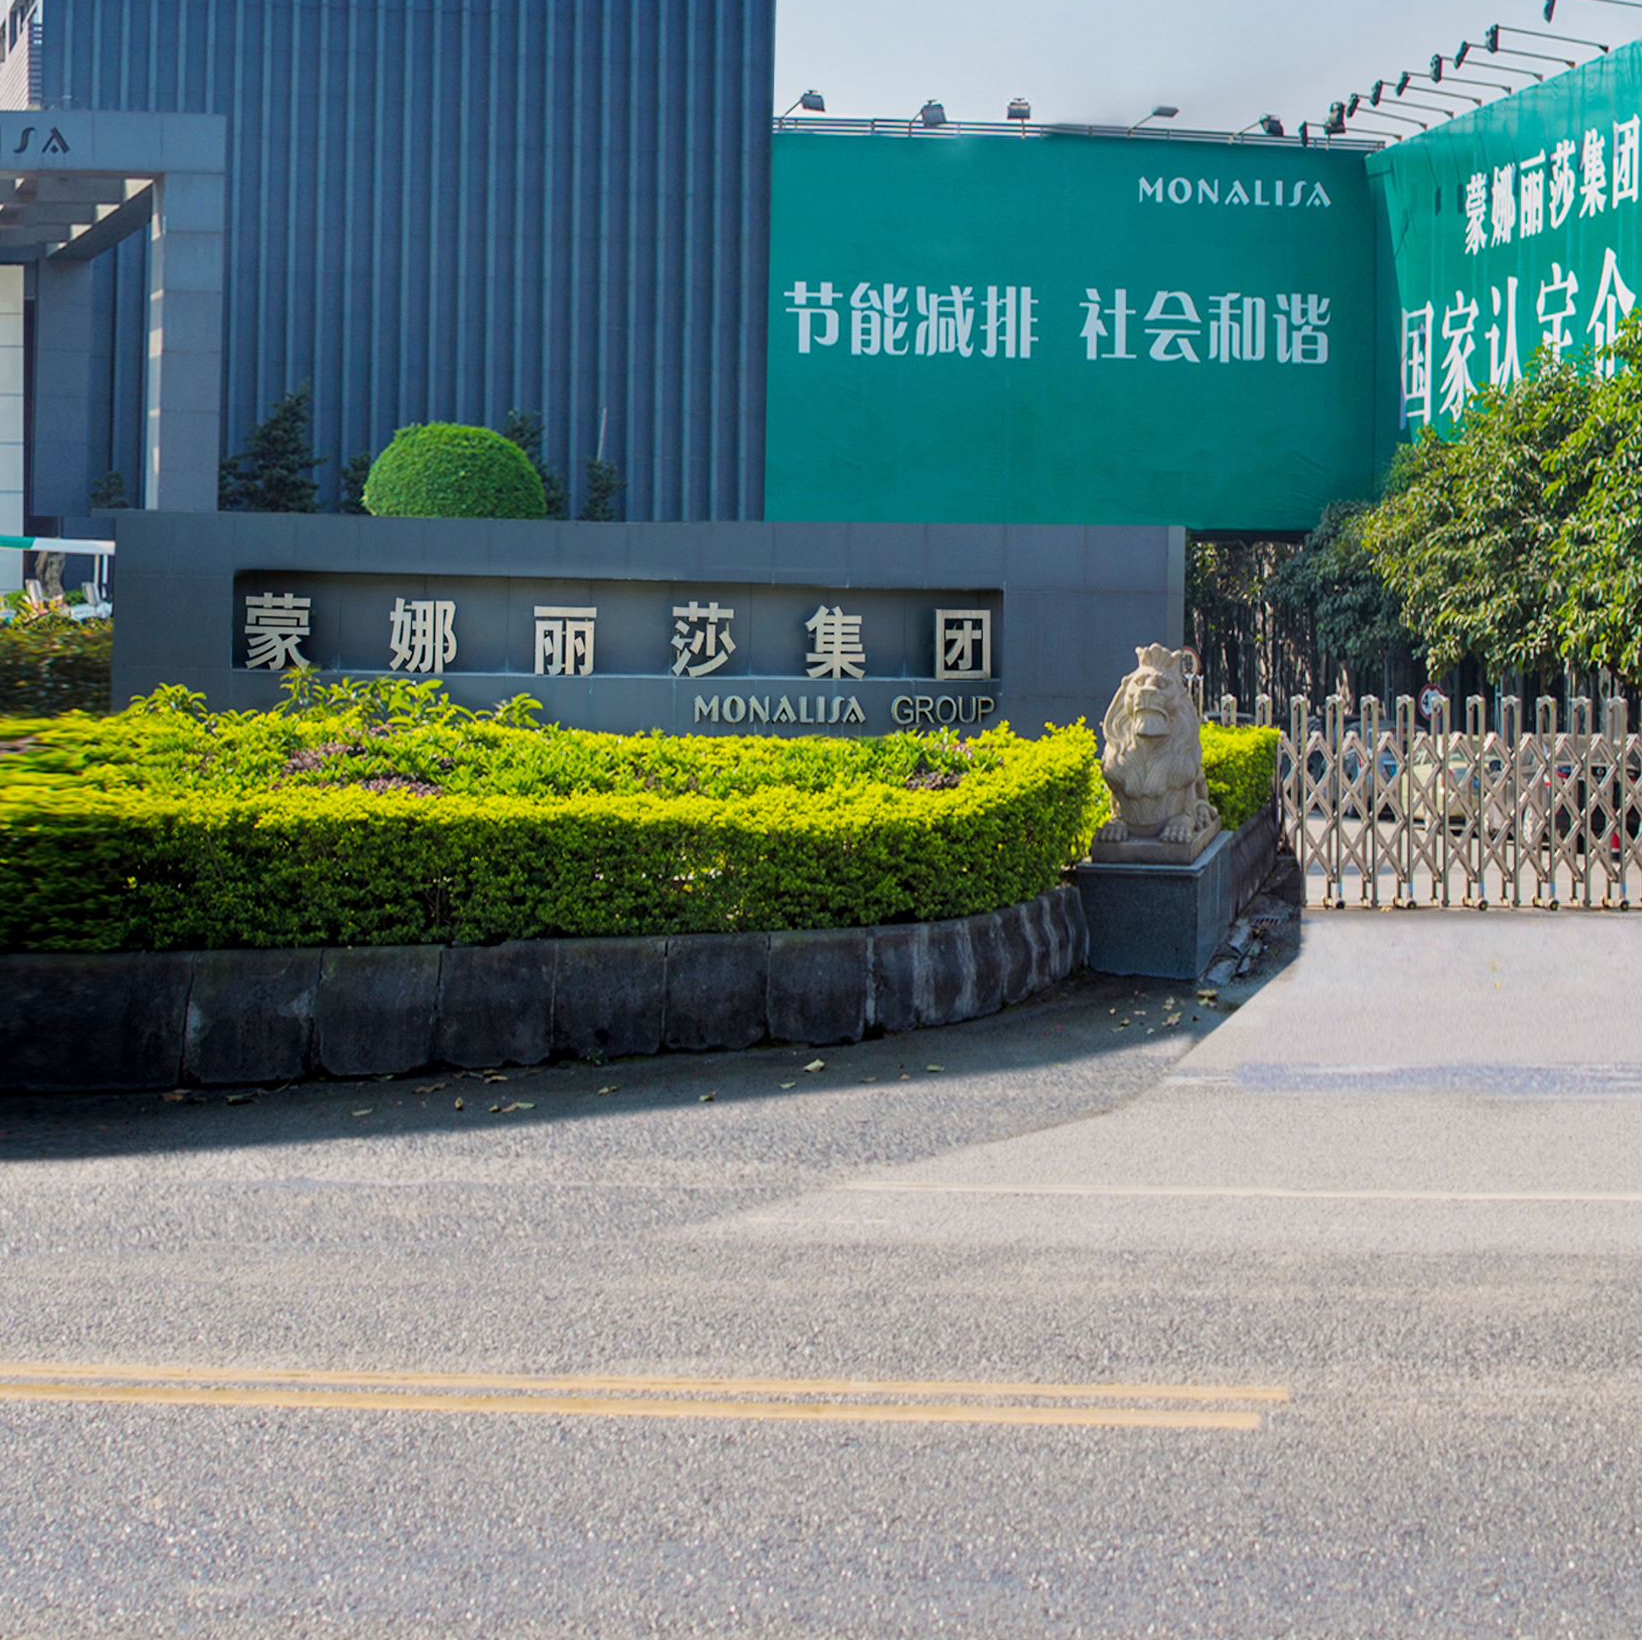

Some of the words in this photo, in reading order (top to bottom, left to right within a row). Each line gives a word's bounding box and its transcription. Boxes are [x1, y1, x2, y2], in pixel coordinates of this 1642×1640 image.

[1138, 176, 1332, 208] MONALISA
[783, 281, 1039, 359] 节能减排
[1079, 287, 1331, 364] 社会和谐
[244, 591, 993, 681] 蒙娜丽莎集团
[694, 694, 866, 724] MONALISA
[891, 694, 995, 725] GROUP
